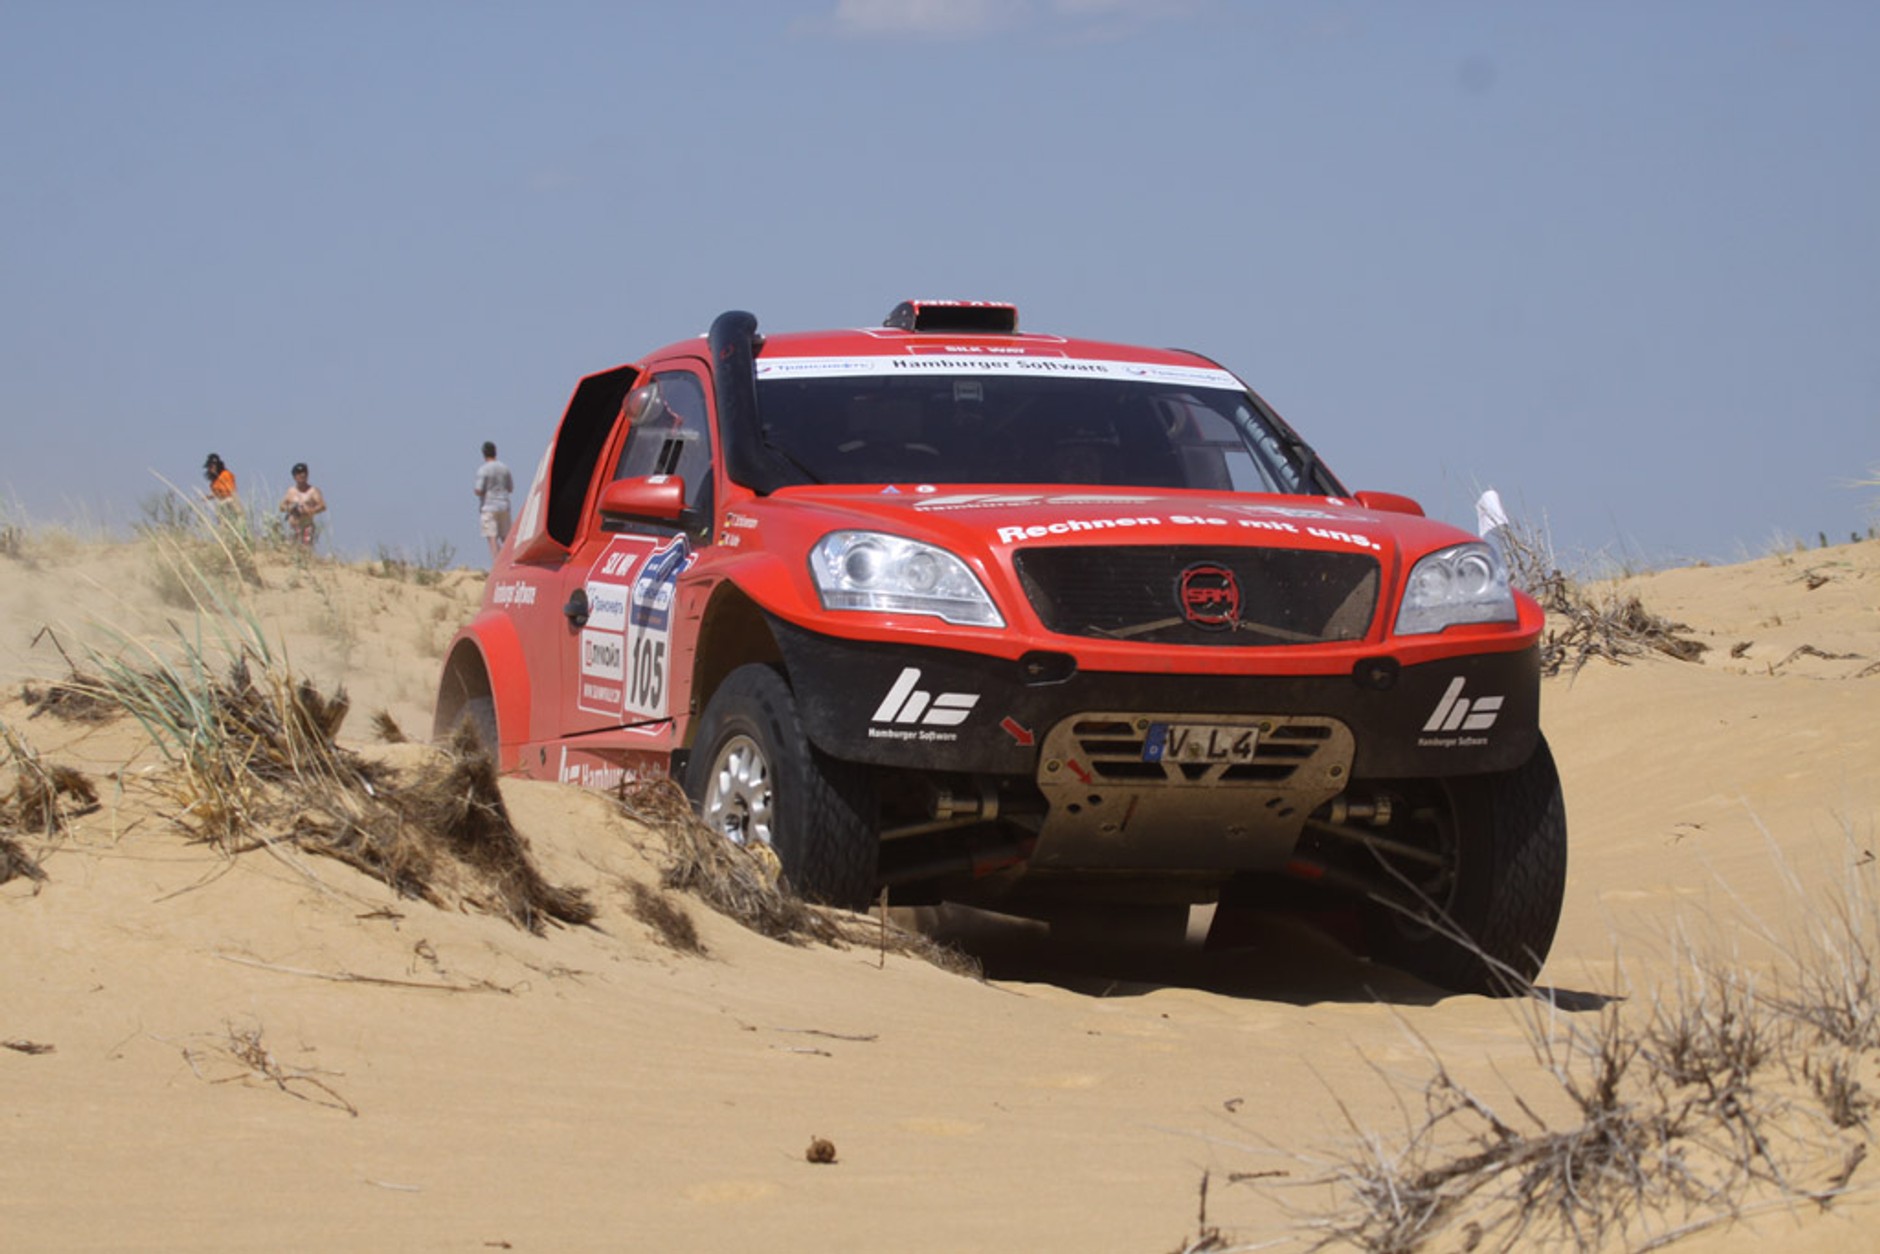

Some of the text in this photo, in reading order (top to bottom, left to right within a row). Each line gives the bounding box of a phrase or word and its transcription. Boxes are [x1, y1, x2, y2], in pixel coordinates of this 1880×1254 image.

[892, 358, 1109, 373] Hamburger Software
[997, 515, 1382, 551] Rechnen Sie mit uns.
[630, 636, 665, 709] 105
[868, 728, 958, 742] Hamburger Software
[1418, 737, 1457, 748] Hamburger
